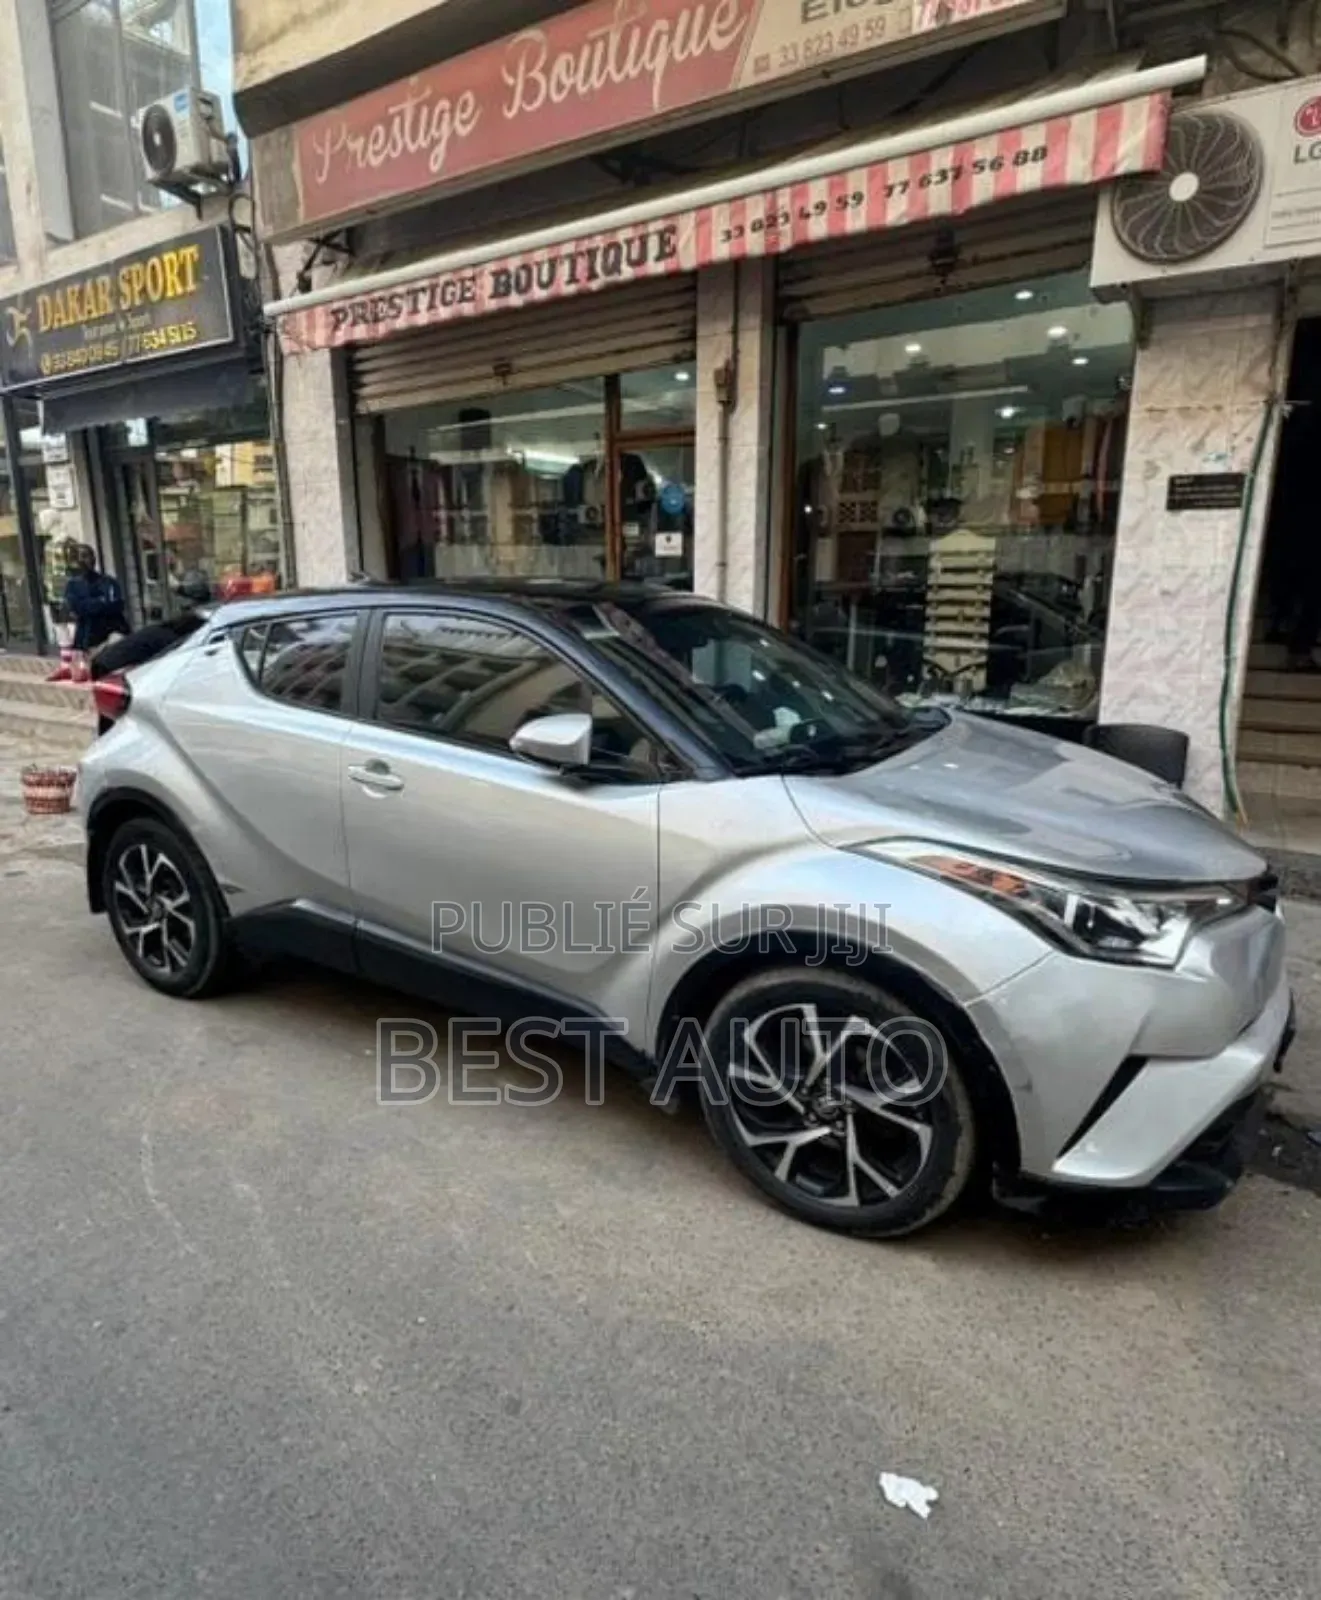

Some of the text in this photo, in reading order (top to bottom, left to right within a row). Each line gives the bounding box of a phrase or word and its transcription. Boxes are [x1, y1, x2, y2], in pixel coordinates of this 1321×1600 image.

[311, 0, 749, 184] Prestige Boutique
[37, 275, 115, 333] DAKAR
[118, 244, 200, 311] SPORT
[330, 275, 478, 332] PRESTIGE
[488, 225, 679, 299] BOUTIQUE
[720, 223, 745, 243] 33
[834, 190, 865, 211] 59
[882, 179, 911, 198] 77
[970, 157, 1005, 176] 56
[1011, 145, 1048, 168] 88
